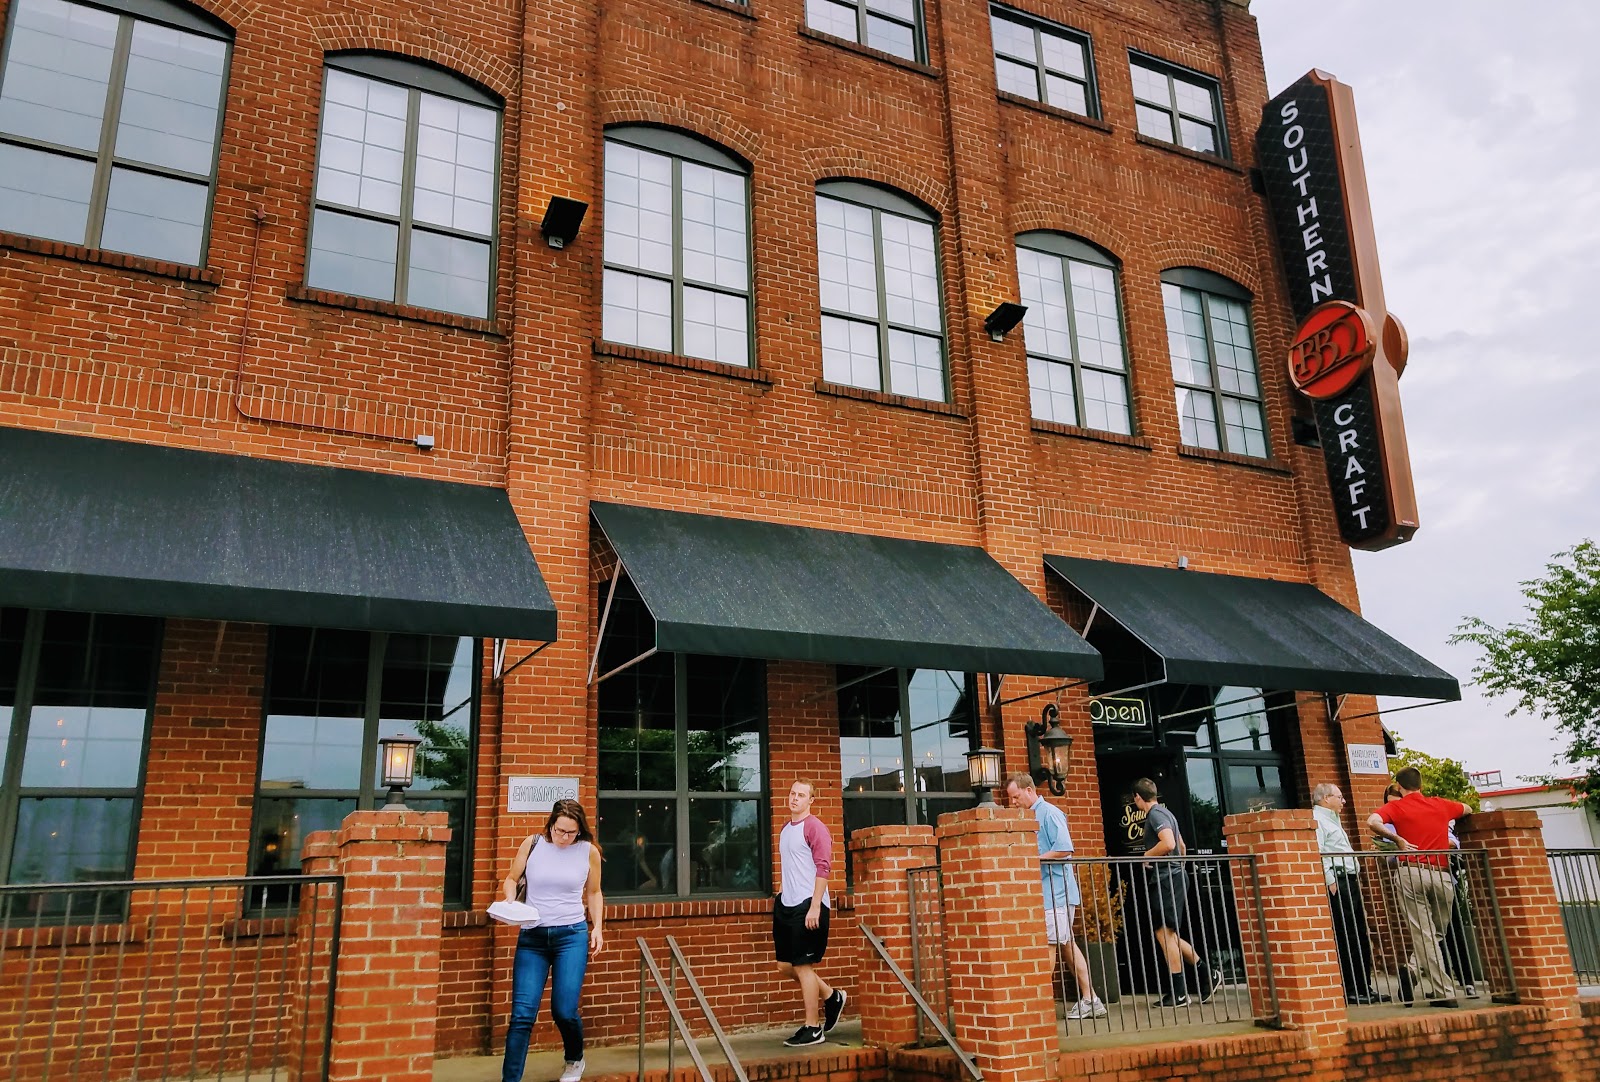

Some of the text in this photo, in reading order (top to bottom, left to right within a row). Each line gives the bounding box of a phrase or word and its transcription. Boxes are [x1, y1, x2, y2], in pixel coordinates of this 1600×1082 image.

[1280, 100, 1334, 304] SOUTHERN
[1333, 403, 1371, 530] CRAFT
[1089, 700, 1141, 726] Open
[512, 785, 564, 802] ENTRANCE
